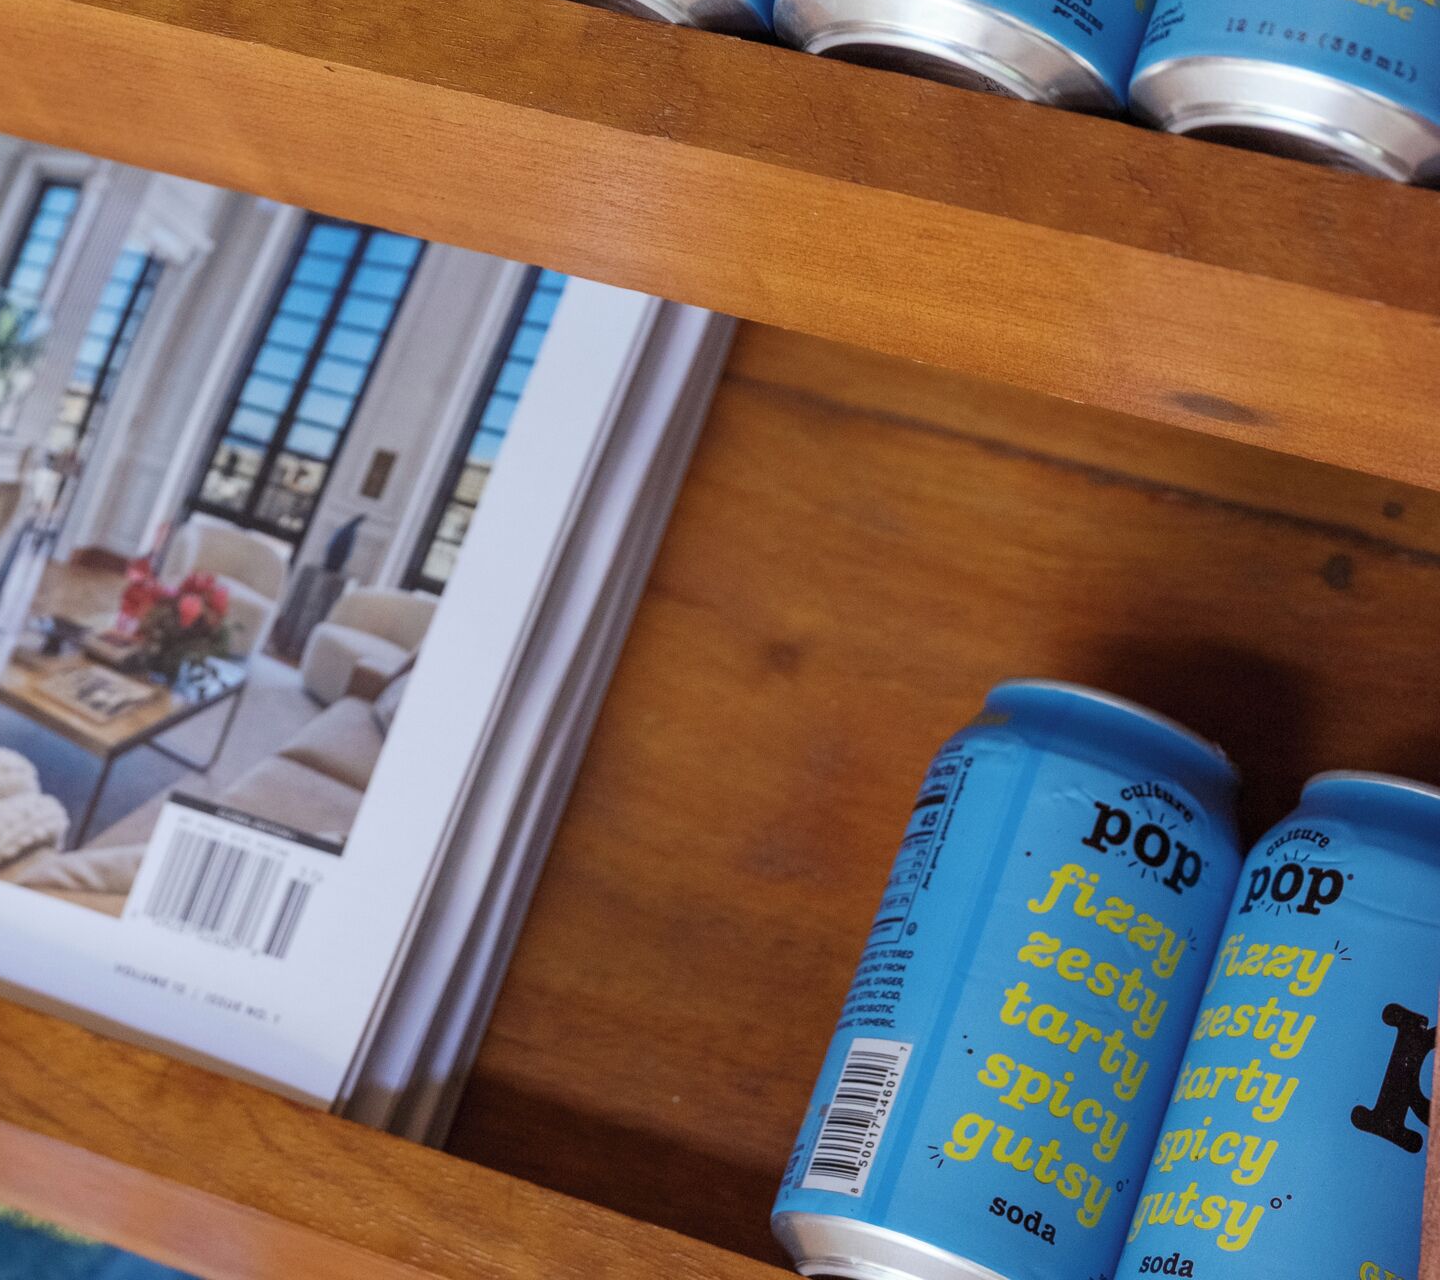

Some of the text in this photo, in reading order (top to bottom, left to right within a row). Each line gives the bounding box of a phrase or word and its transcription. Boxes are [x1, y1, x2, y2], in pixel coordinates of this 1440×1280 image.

[1120, 781, 1195, 824] culture
[1081, 800, 1203, 895] pop
[1265, 828, 1331, 857] culture
[1026, 863, 1188, 979] fizzy
[1238, 863, 1345, 916] pop
[1017, 931, 1169, 1040] zesty
[1206, 932, 1336, 997] fizzy
[1000, 982, 1151, 1101] tarty
[1193, 996, 1317, 1060] zesty
[977, 1051, 1128, 1163] spicy
[1172, 1058, 1300, 1123] tarty
[942, 1112, 1112, 1228] gutsy
[1153, 1116, 1279, 1186] spicy
[988, 1197, 1057, 1246] soda
[1125, 1181, 1265, 1251] gutsy
[1138, 1252, 1194, 1279] soda
